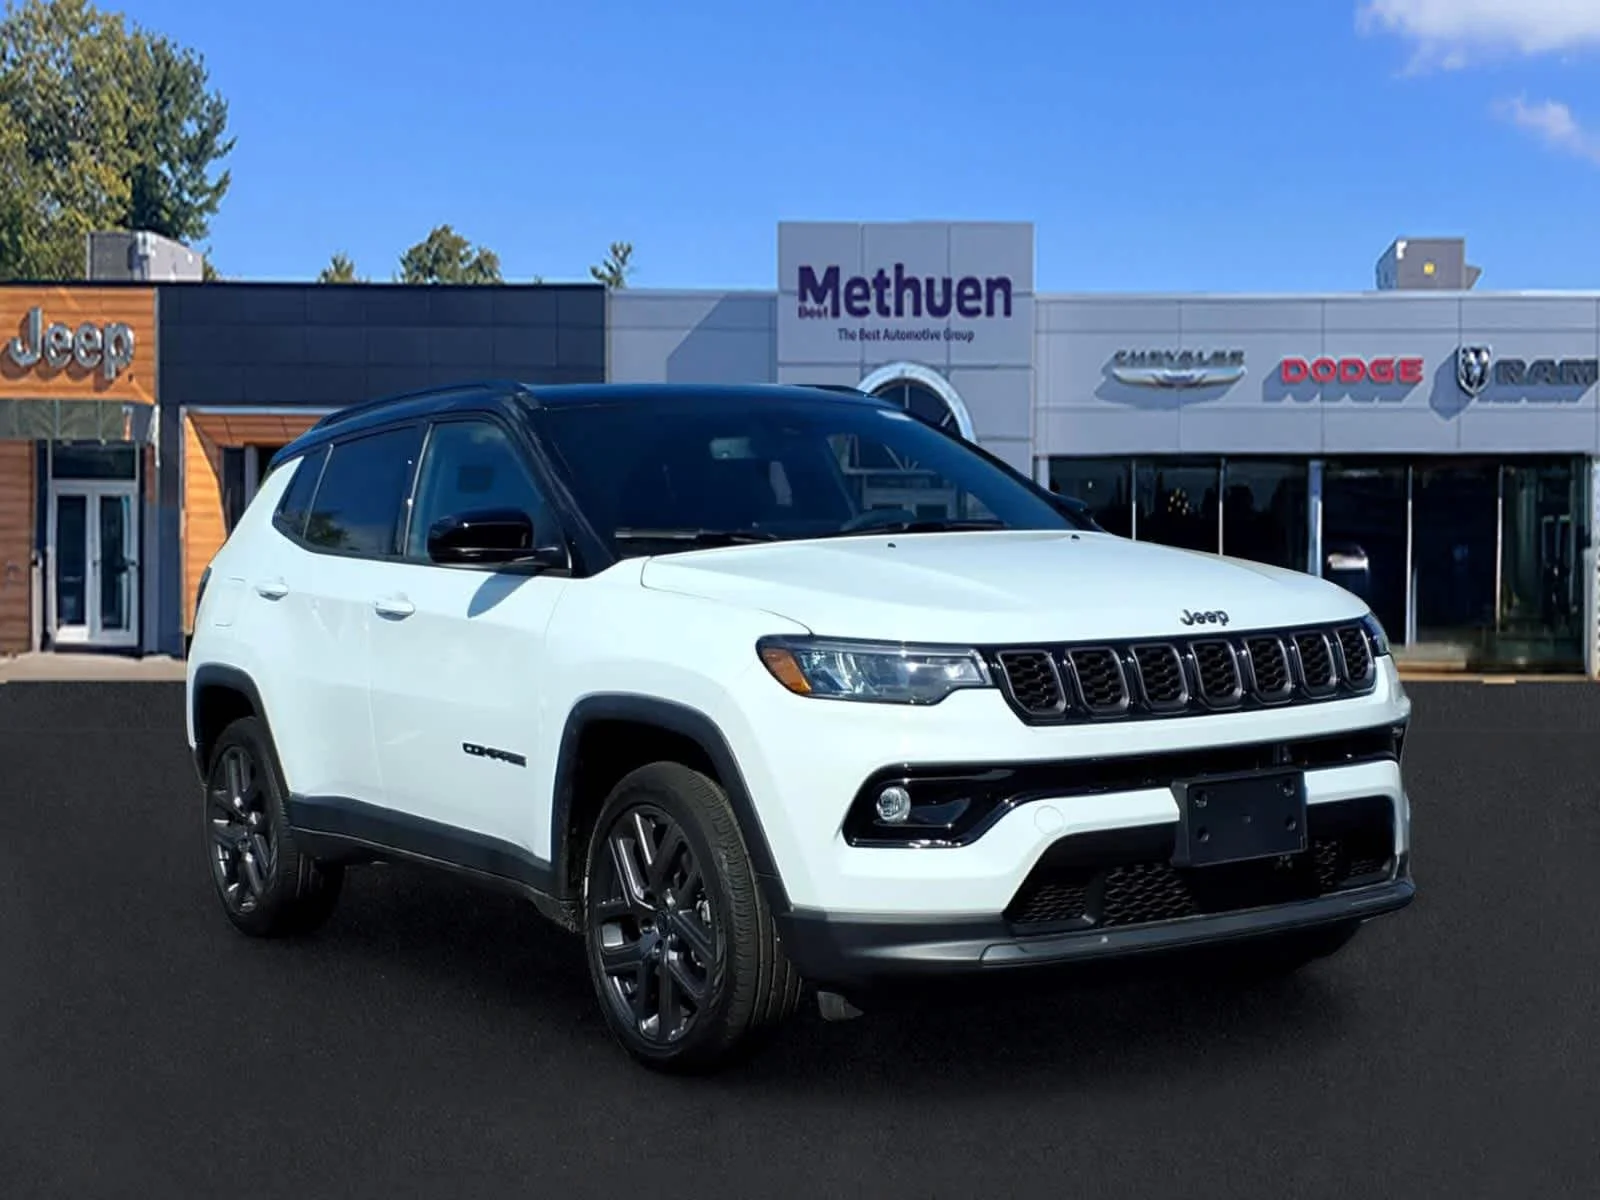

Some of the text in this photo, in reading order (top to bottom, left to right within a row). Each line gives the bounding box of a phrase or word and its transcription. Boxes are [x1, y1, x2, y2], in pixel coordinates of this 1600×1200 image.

[798, 263, 1012, 318] Methuen
[799, 306, 829, 319] Best
[9, 307, 135, 380] Jeep
[838, 328, 975, 343] The Best Automotive Group
[1281, 358, 1424, 383] DODGE
[1495, 359, 1598, 385] RAM
[1180, 609, 1230, 626] Jeep
